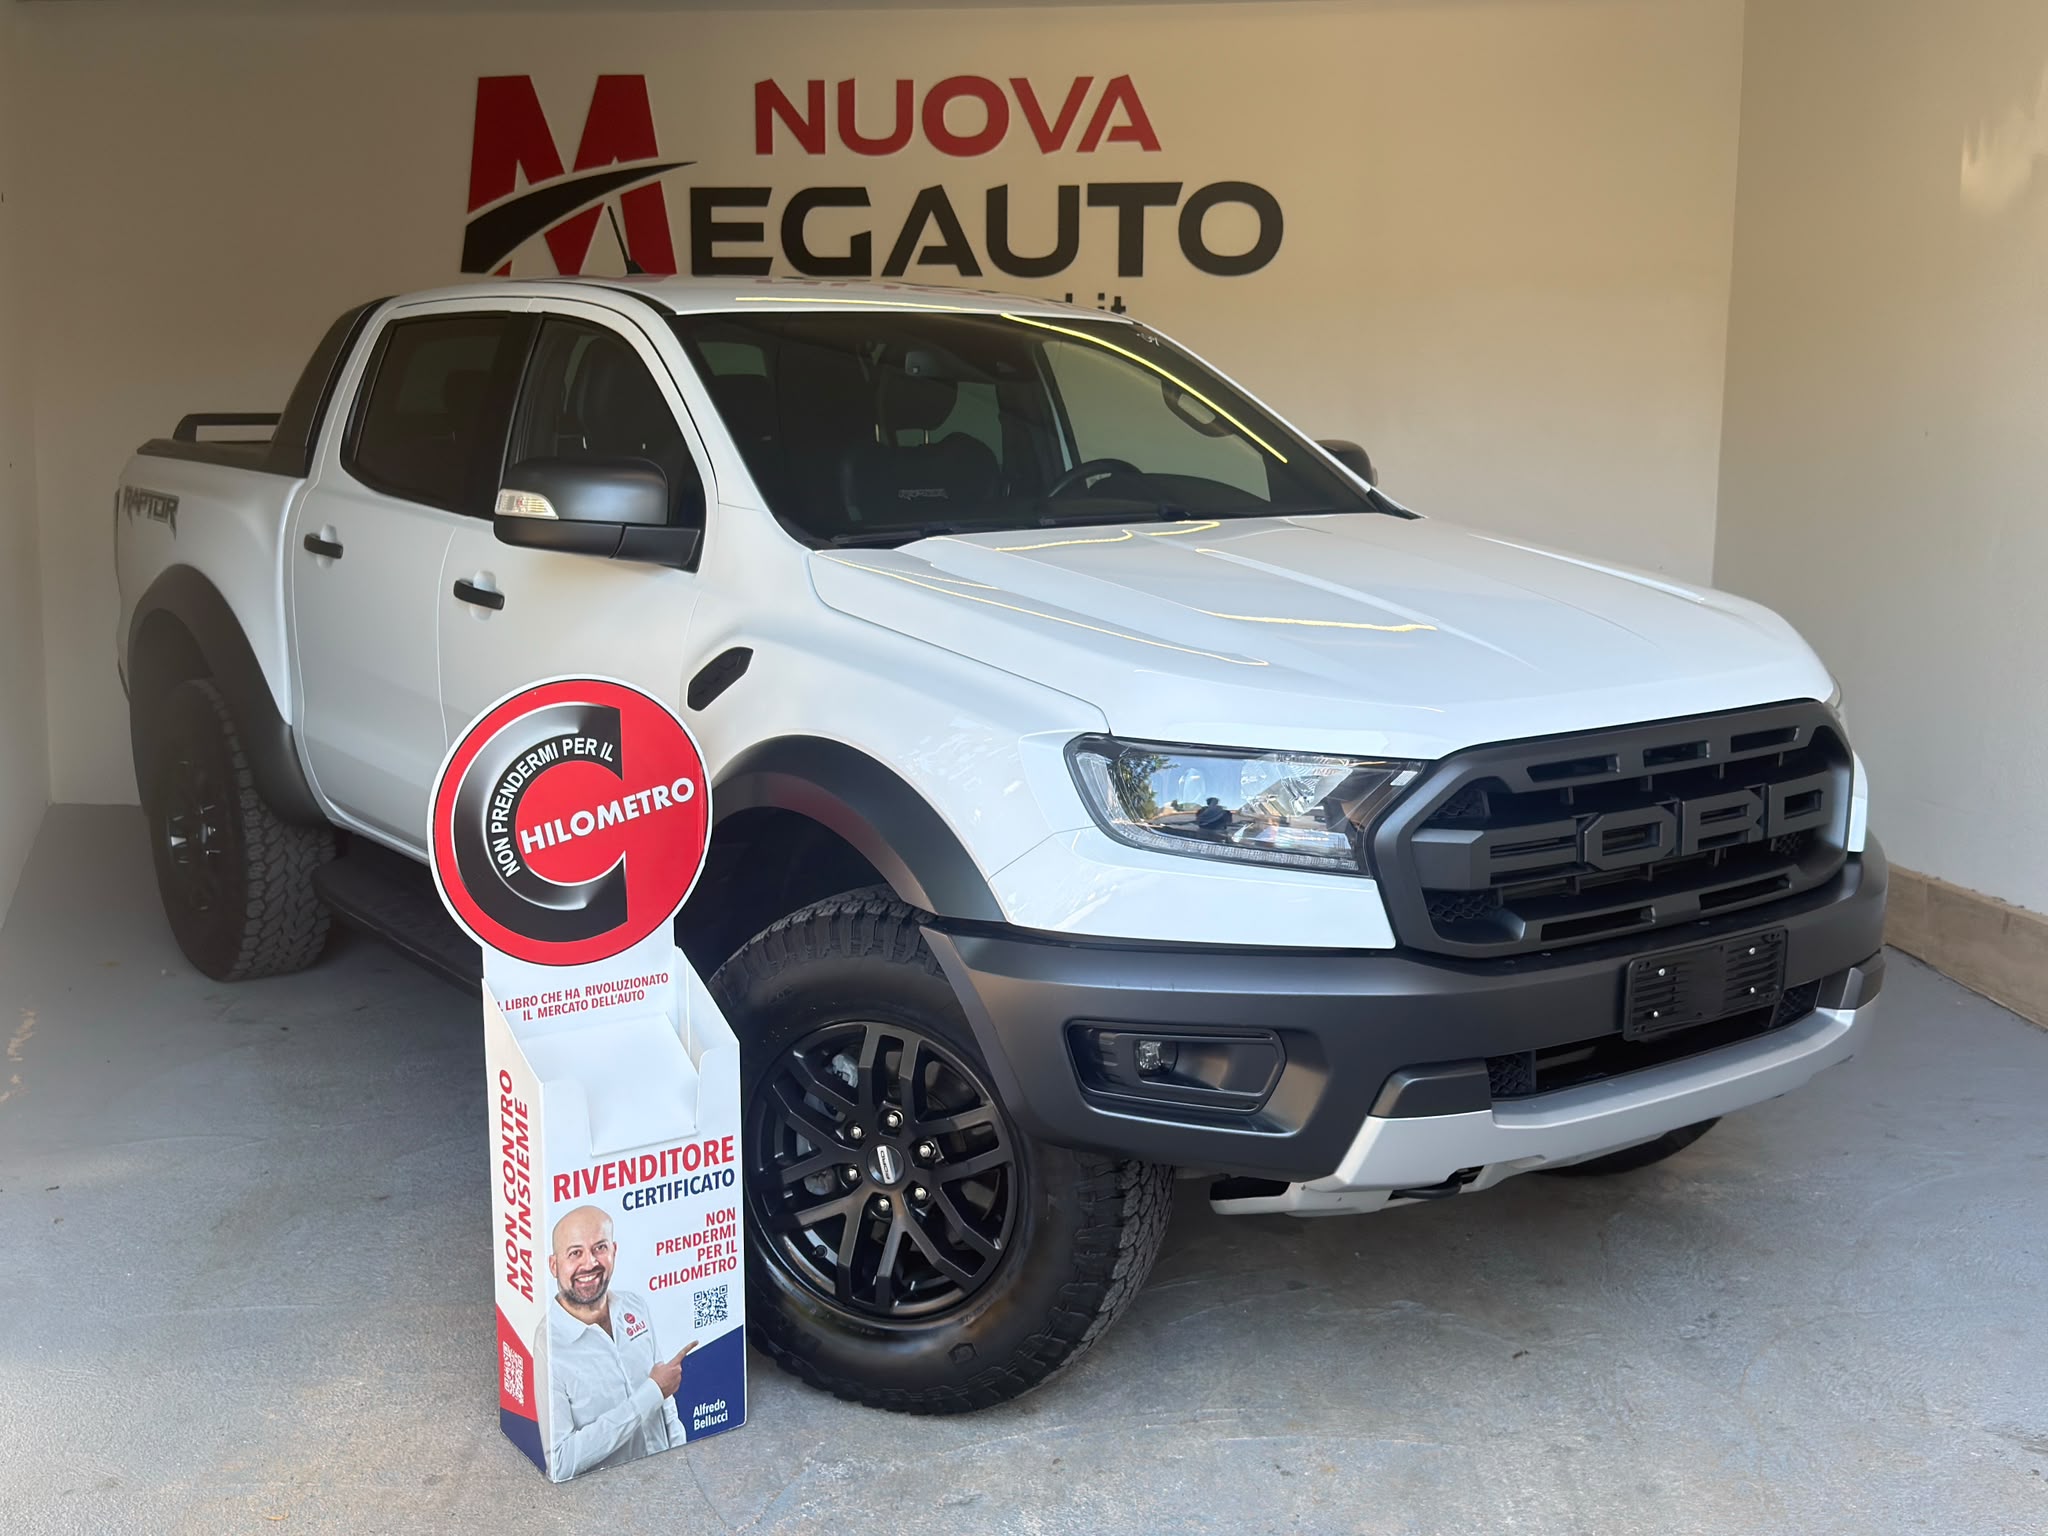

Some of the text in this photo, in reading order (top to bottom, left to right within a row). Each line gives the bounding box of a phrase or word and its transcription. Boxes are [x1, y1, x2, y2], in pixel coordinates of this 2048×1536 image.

[755, 74, 1162, 156] NUOVA
[491, 737, 615, 877] NON PRENDERMI PER IL
[1460, 770, 1829, 891] FORD
[505, 995, 538, 1012] LIBRO
[541, 990, 563, 1005] CHE
[565, 988, 581, 1000] HA
[585, 972, 669, 997] RIVOLUZIONATO
[522, 1009, 533, 1021] IL
[537, 999, 589, 1019] MERCATO
[499, 1069, 519, 1290] NON CONTRO
[553, 1135, 735, 1203] RIVENDITORE
[514, 1097, 534, 1303] MA INSIEME
[622, 1168, 736, 1211] CERTIFICATO
[705, 1207, 736, 1228] NON
[655, 1224, 737, 1256] PRENDERMI
[697, 1240, 738, 1262] PER IL
[649, 1256, 737, 1291] CHILOMETRO
[693, 1398, 726, 1418] Alfredo
[693, 1410, 728, 1431] Bellucci
